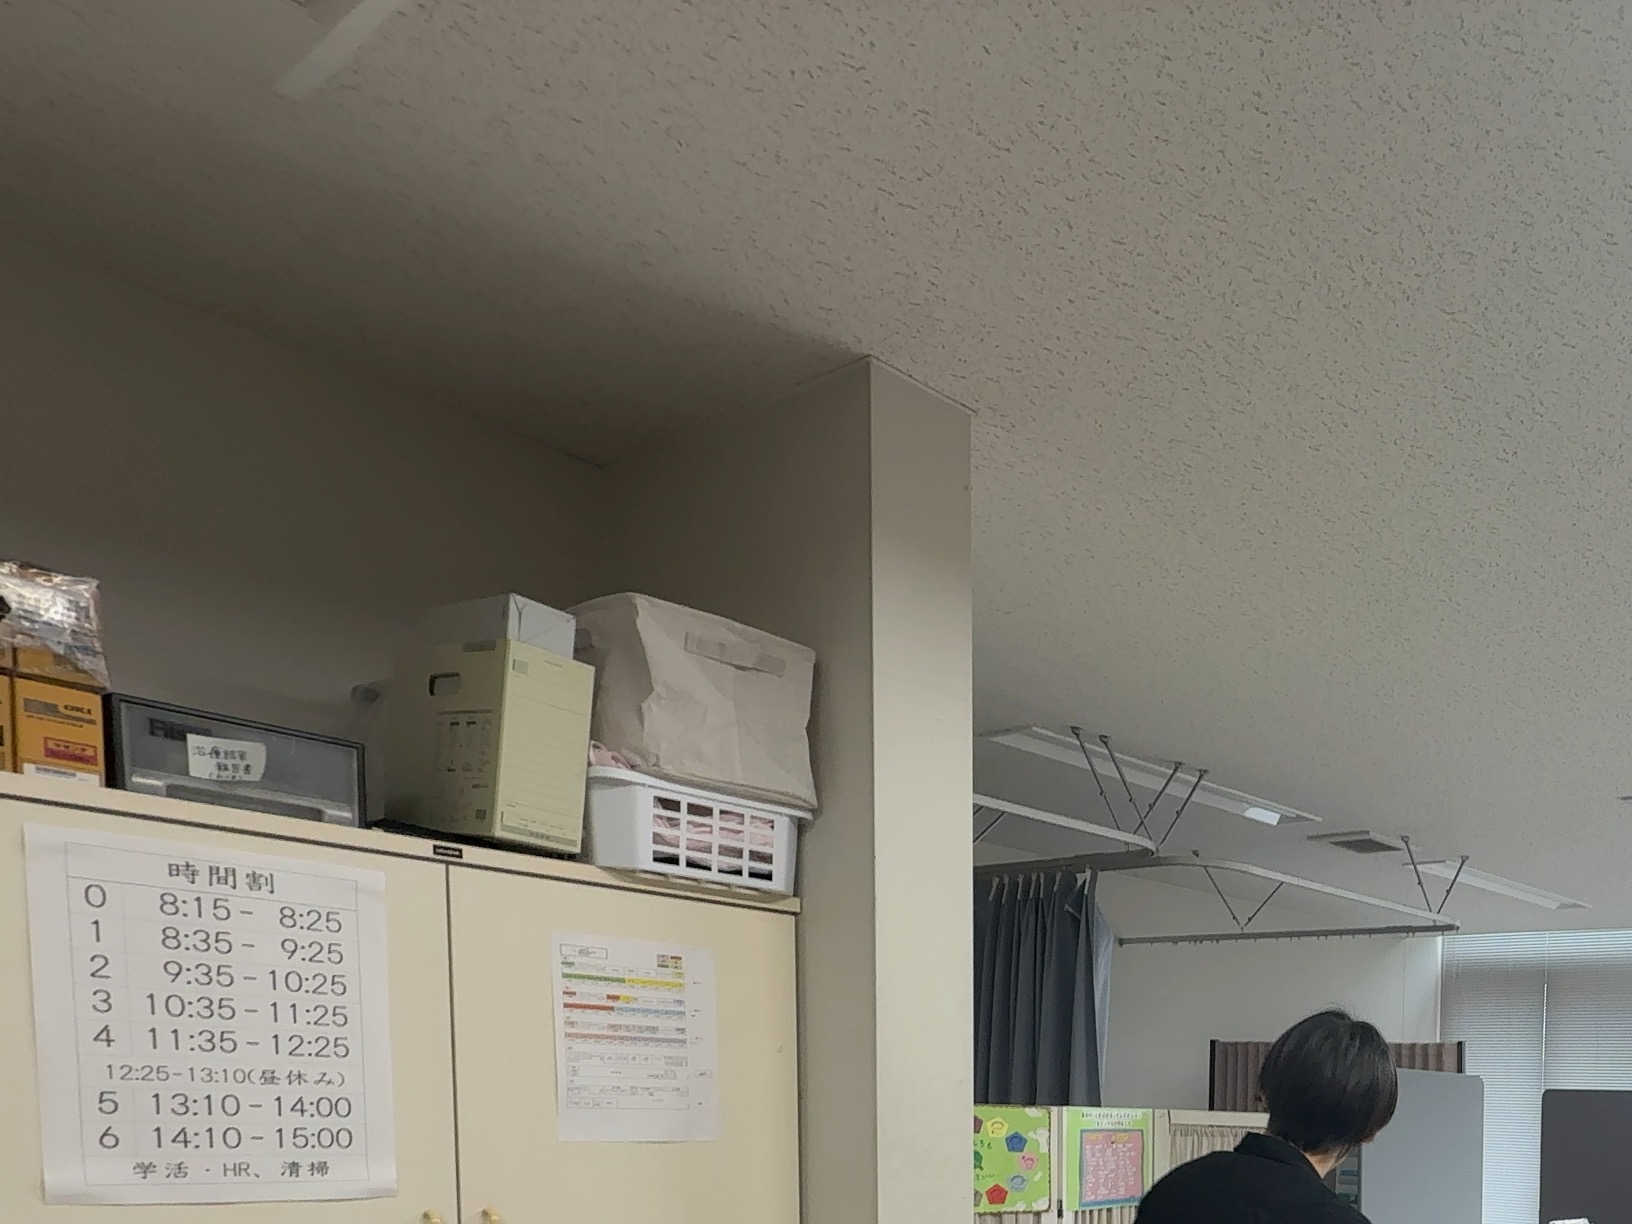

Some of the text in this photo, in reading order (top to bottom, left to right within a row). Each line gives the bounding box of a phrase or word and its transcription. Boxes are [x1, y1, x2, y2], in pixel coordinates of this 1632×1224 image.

[168, 861, 275, 895] 時間割
[84, 884, 106, 908] 0
[90, 920, 102, 943] 1
[90, 955, 111, 979] 2
[92, 989, 113, 1014] 3
[93, 1025, 115, 1048] 4
[98, 1091, 119, 1115] 5
[99, 1126, 120, 1149] 6
